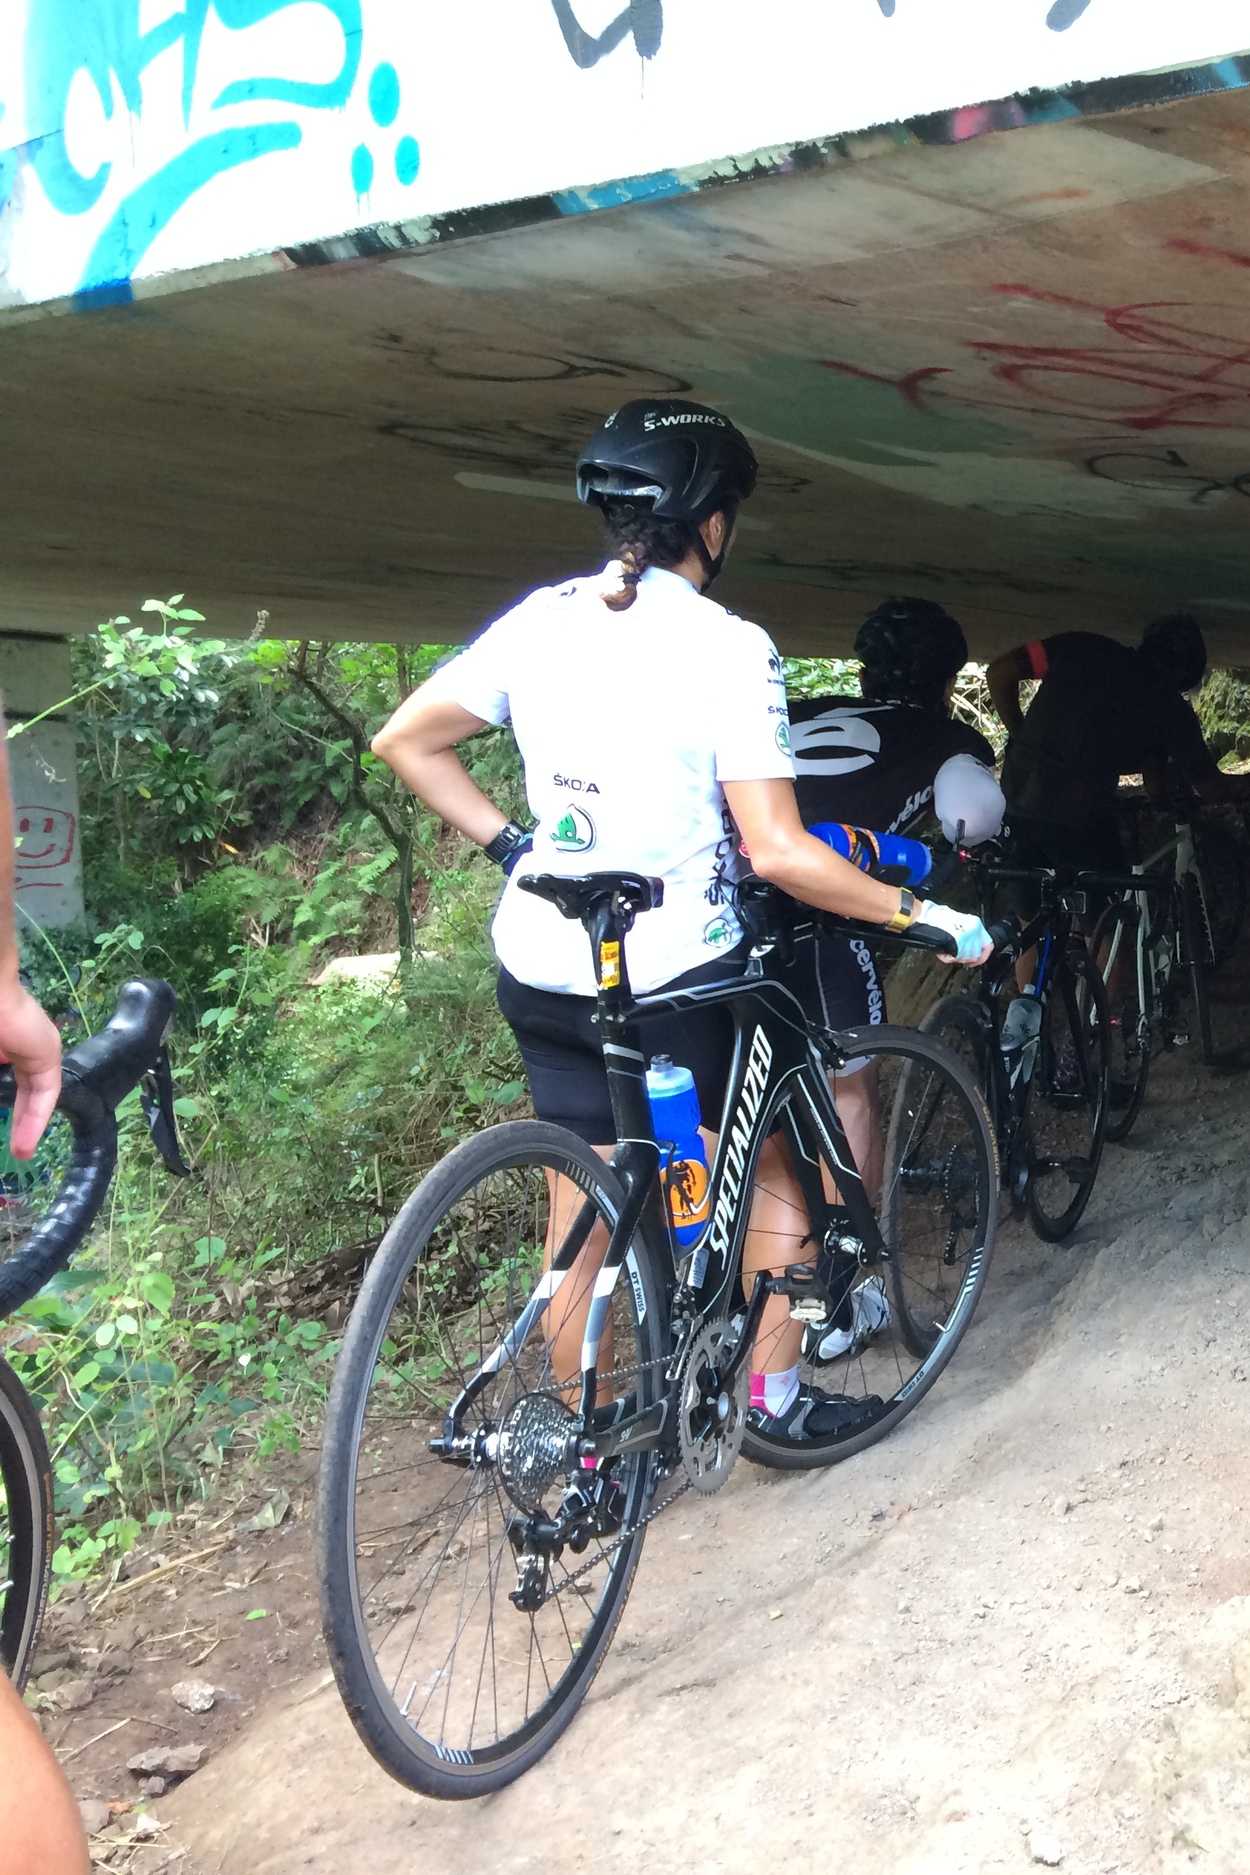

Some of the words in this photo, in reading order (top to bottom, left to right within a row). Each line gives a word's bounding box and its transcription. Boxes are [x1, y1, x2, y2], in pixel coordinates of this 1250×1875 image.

[644, 413, 726, 432] S-WORKS
[553, 773, 600, 794] ŠKOA
[704, 798, 735, 906] ŠKOD
[710, 1024, 773, 1271] SPECIALIZED
[631, 1271, 640, 1286] DT
[635, 1287, 645, 1313] SWISS
